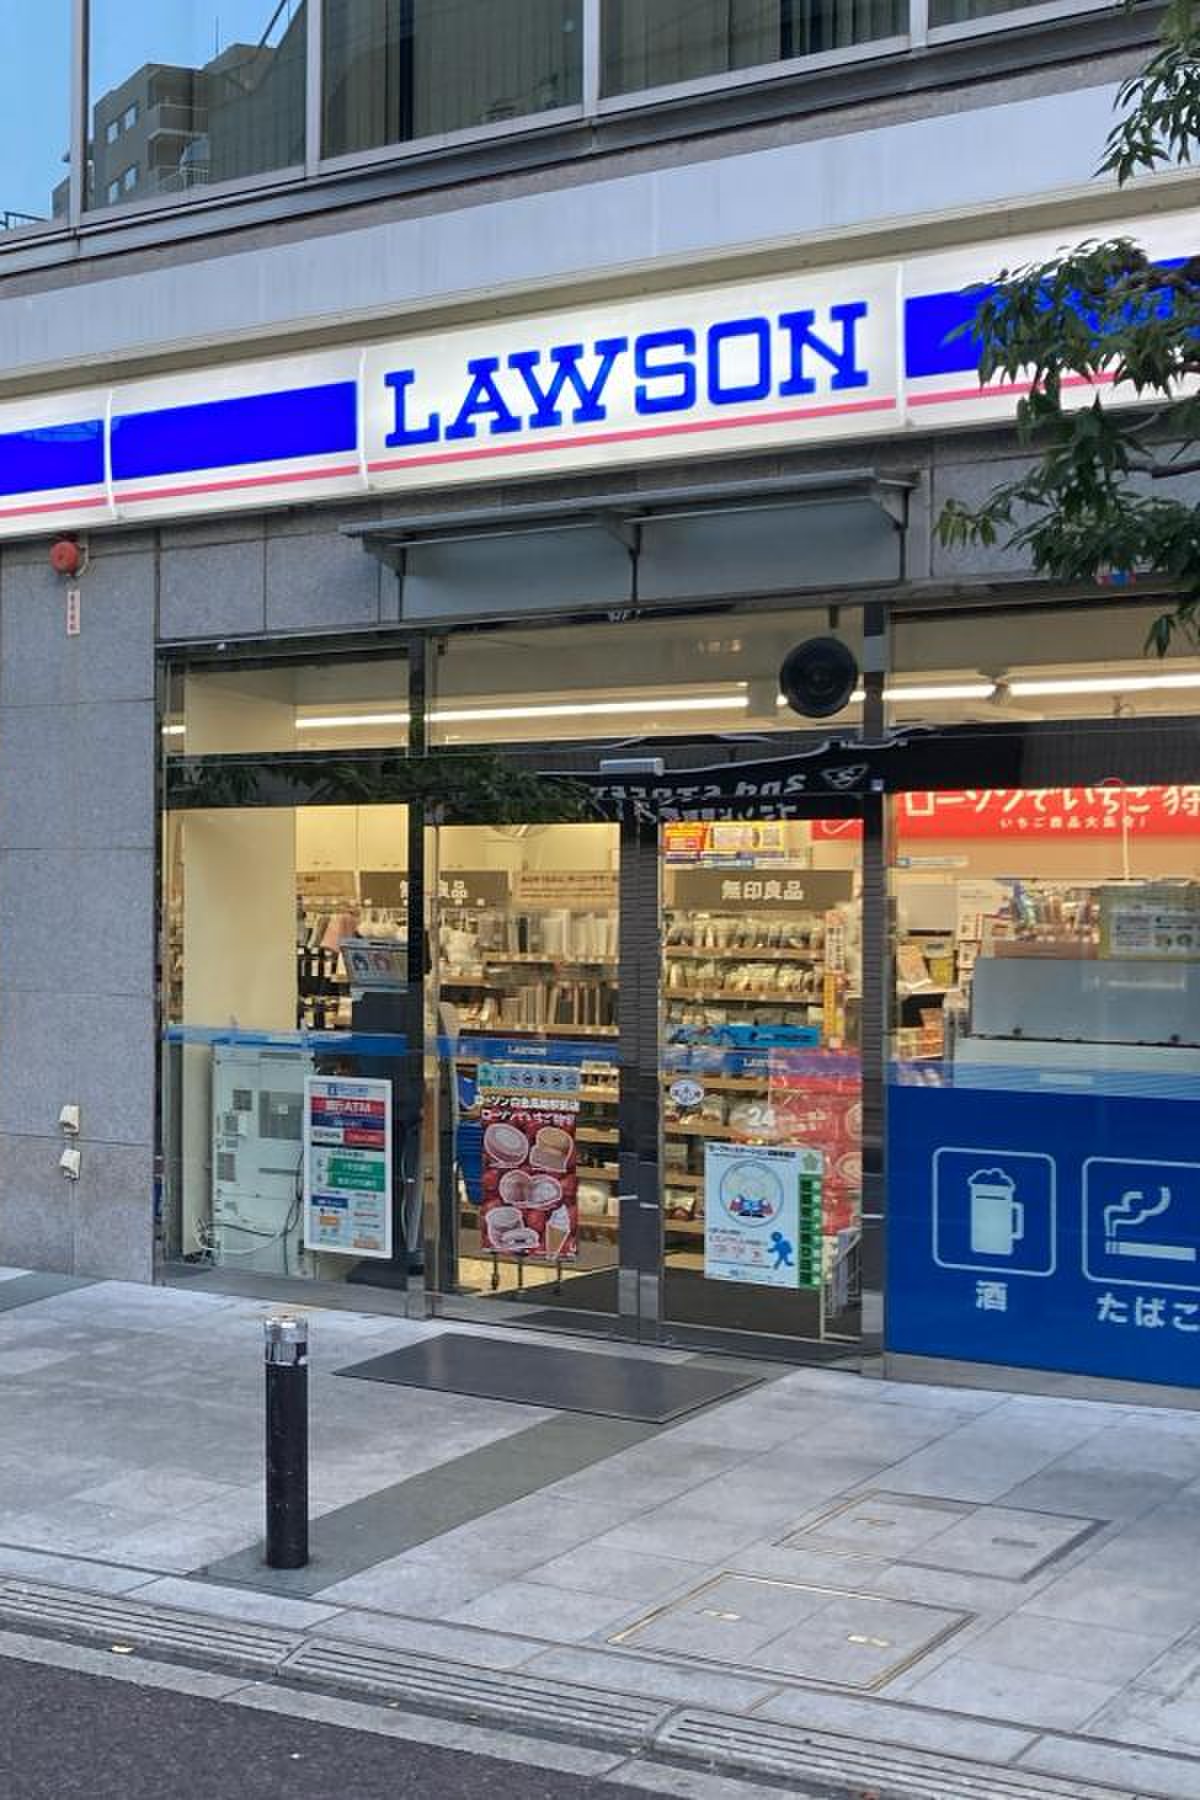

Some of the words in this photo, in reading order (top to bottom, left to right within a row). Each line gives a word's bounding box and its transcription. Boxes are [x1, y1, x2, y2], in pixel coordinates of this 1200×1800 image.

[383, 301, 869, 449] LAWSON
[721, 880, 804, 900] 無印良品
[975, 1279, 1008, 1312] 酒
[1097, 1292, 1200, 1332] たばこ
